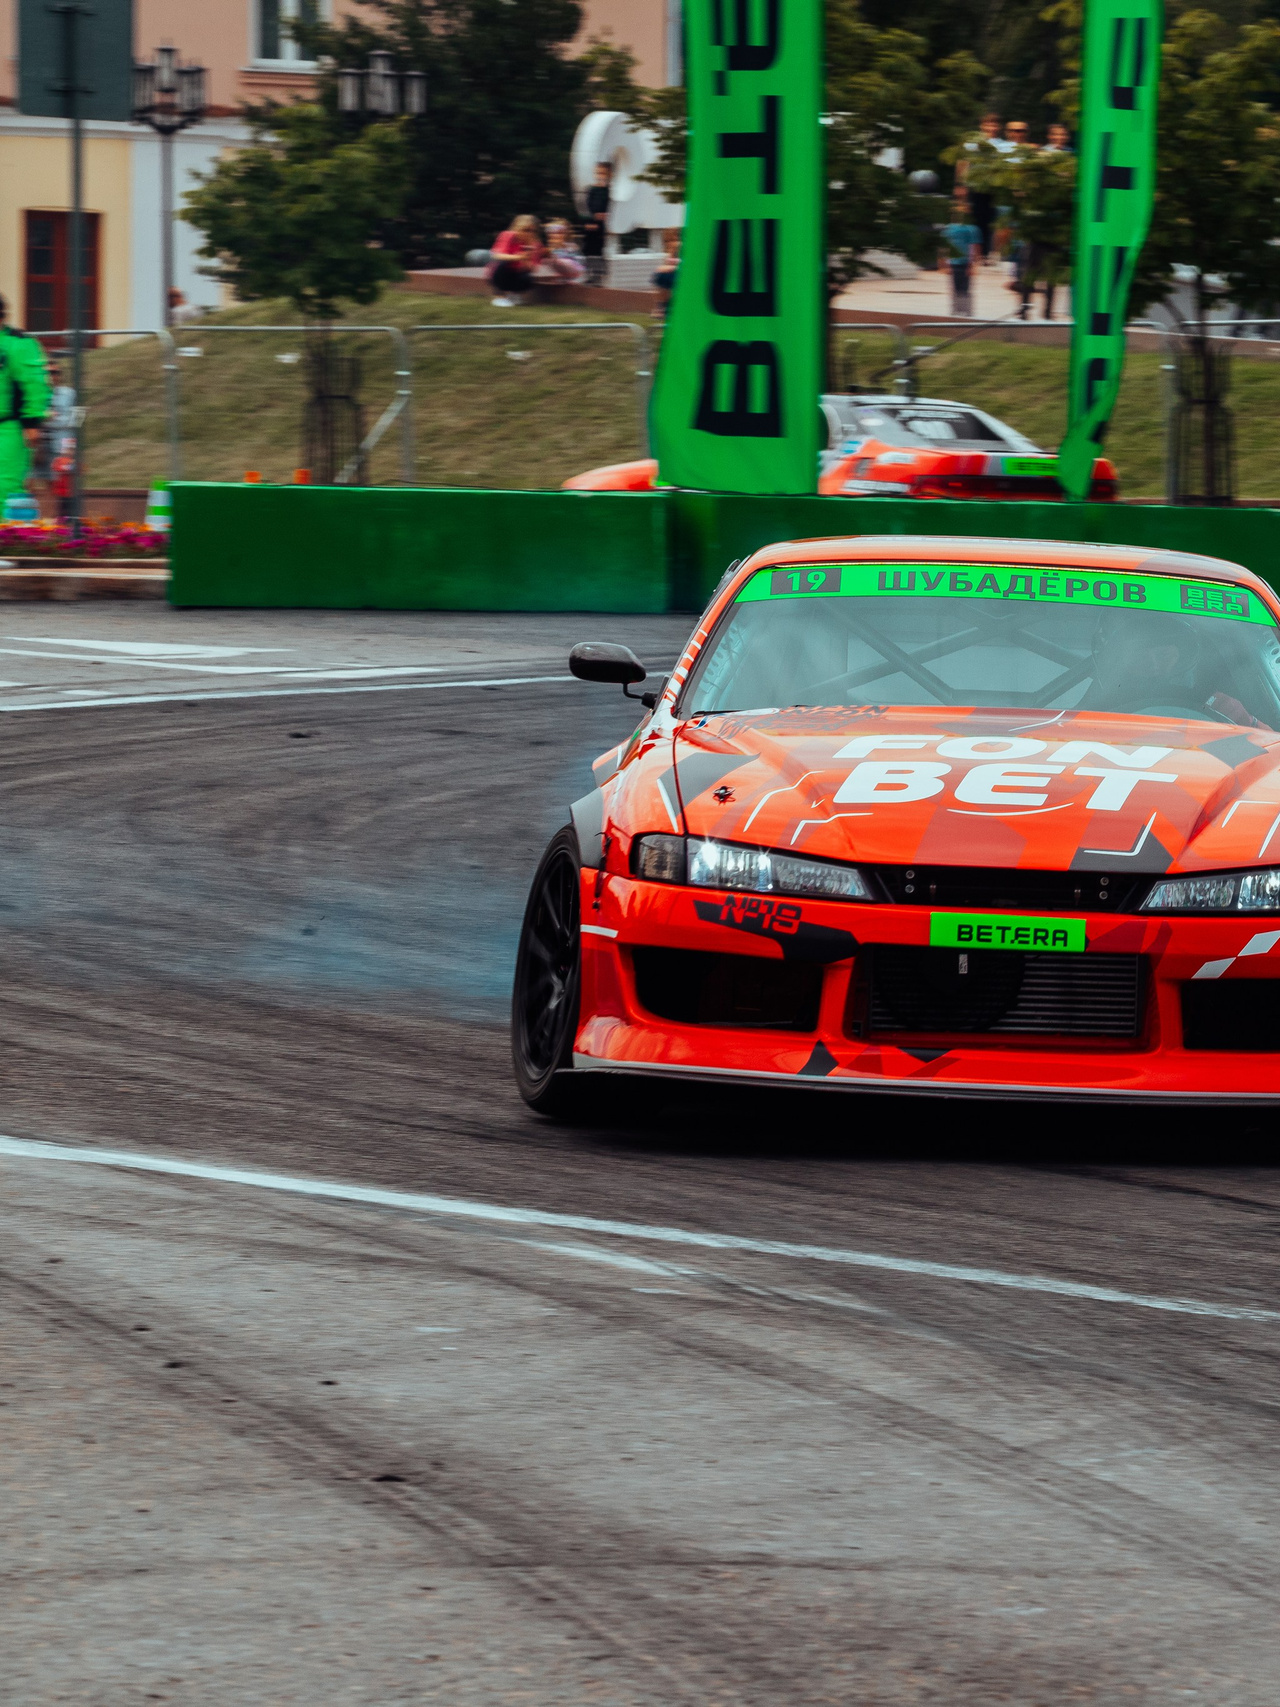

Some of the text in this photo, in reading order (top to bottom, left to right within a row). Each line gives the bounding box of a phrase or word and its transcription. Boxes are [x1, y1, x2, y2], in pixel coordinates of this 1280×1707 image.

[786, 570, 827, 592] 19
[877, 570, 1148, 604] ШУБАДЁРОВ
[832, 734, 1175, 769] FON
[832, 761, 1180, 812] BET
[956, 923, 1069, 948] BETERA
